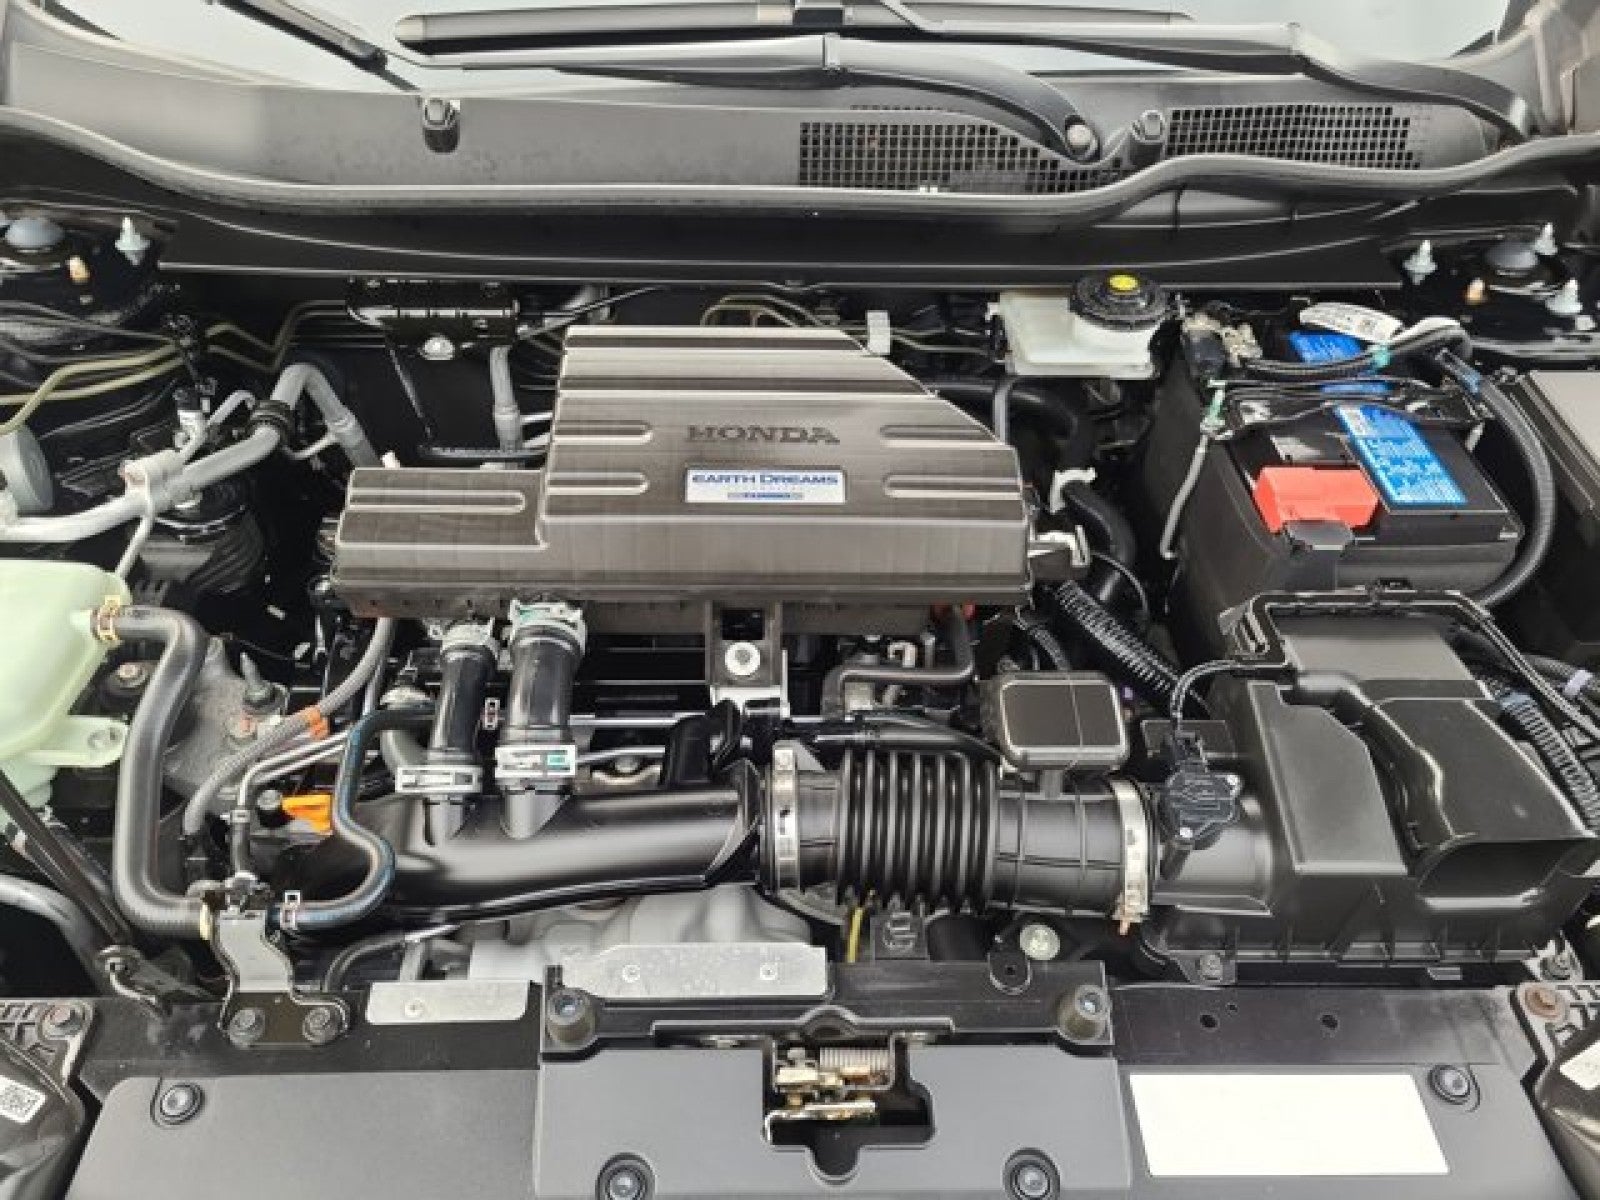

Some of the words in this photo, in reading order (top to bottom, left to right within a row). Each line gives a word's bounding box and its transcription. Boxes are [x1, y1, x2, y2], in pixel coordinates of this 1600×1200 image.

[686, 425, 841, 445] HONDA
[692, 474, 756, 484] EARTH
[759, 474, 839, 485] DREAMS
